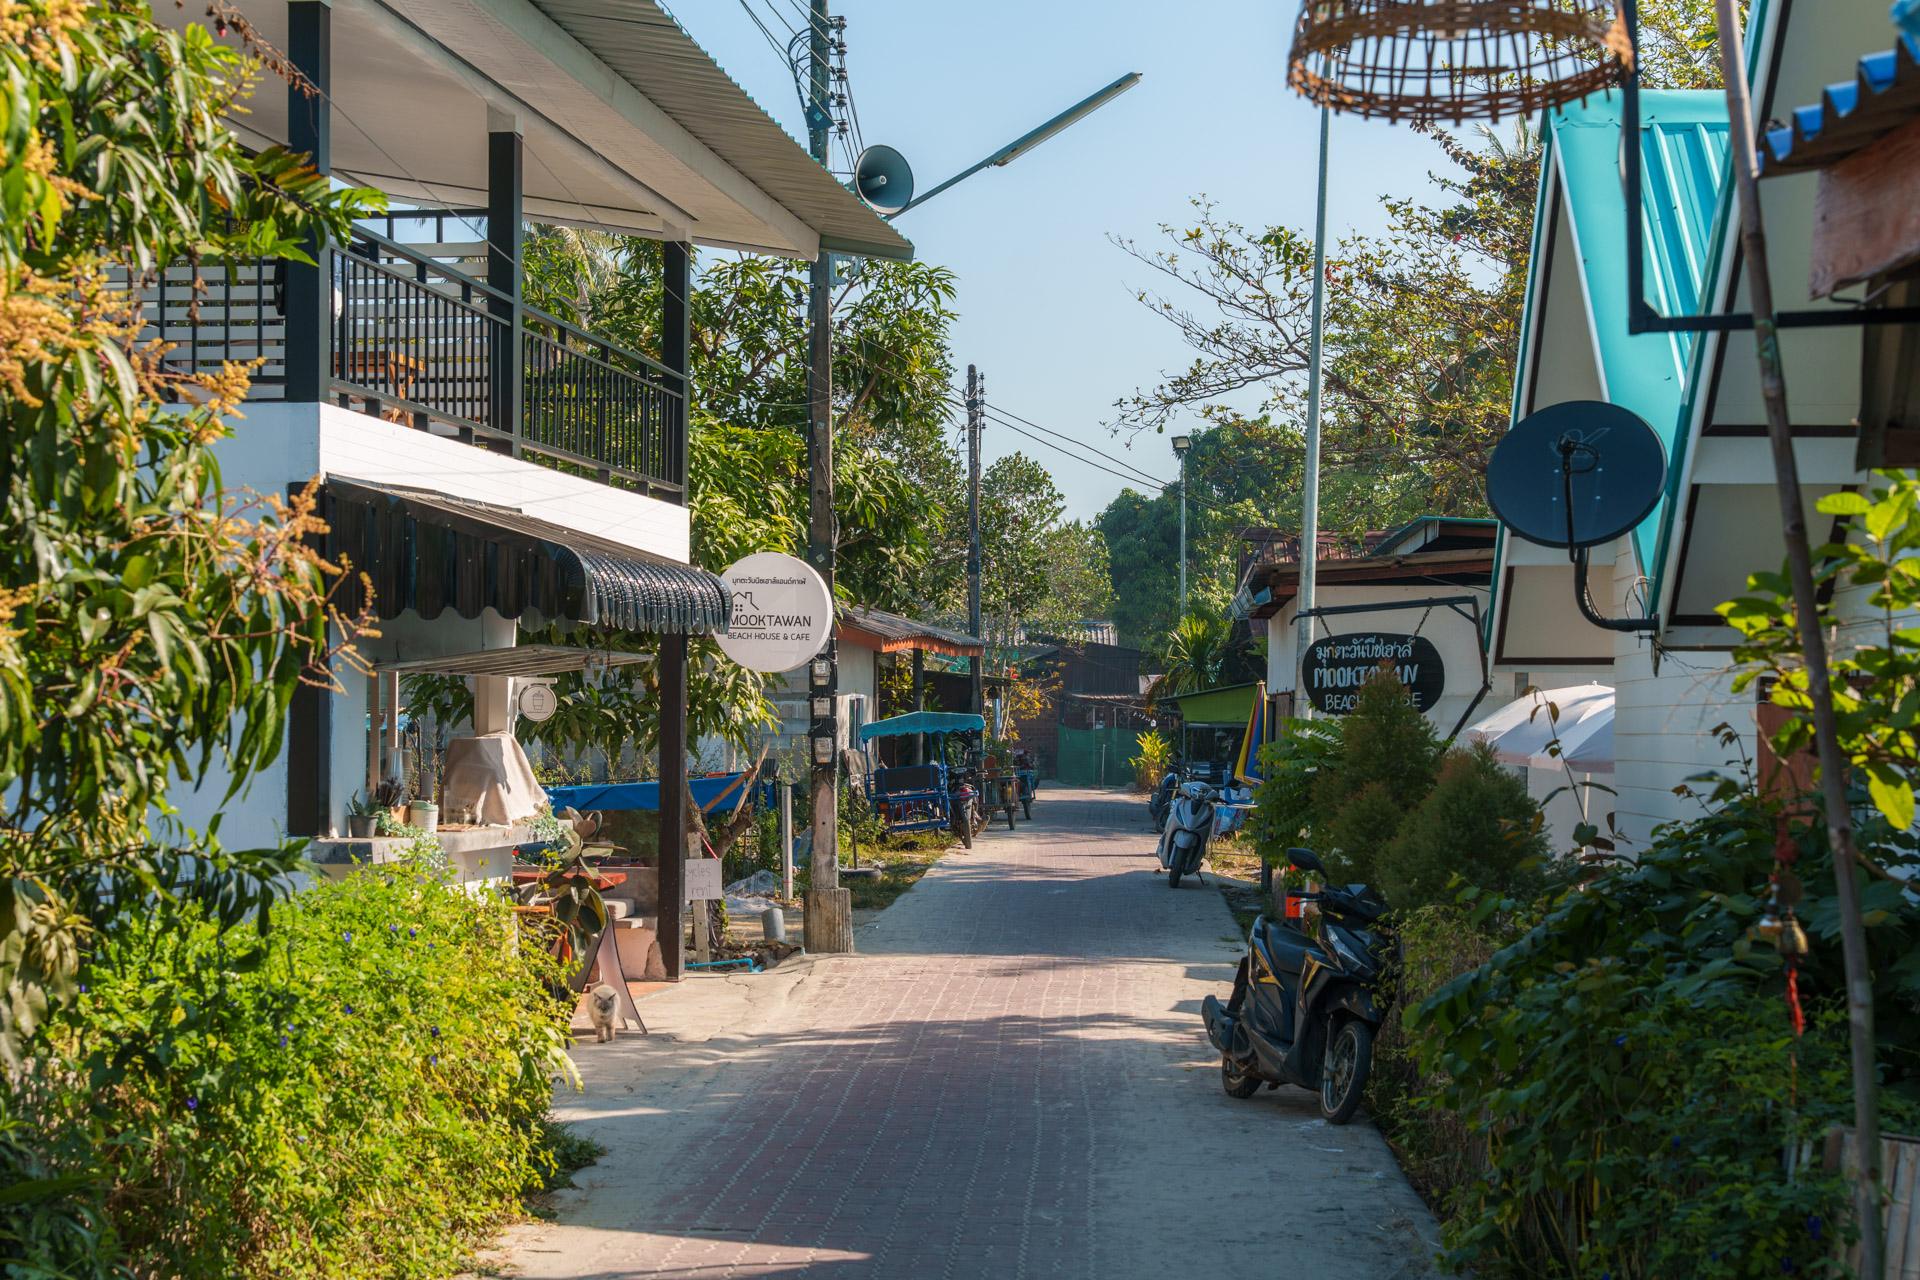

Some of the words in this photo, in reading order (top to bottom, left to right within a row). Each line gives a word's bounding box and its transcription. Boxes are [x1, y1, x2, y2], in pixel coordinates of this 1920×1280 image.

[731, 614, 811, 627] MOOKTAWAN
[727, 632, 753, 640] BEACH
[754, 632, 780, 640] HOUSE
[782, 632, 789, 641] &
[791, 633, 810, 641] CAFE
[1313, 663, 1419, 689] MOOKTAAN
